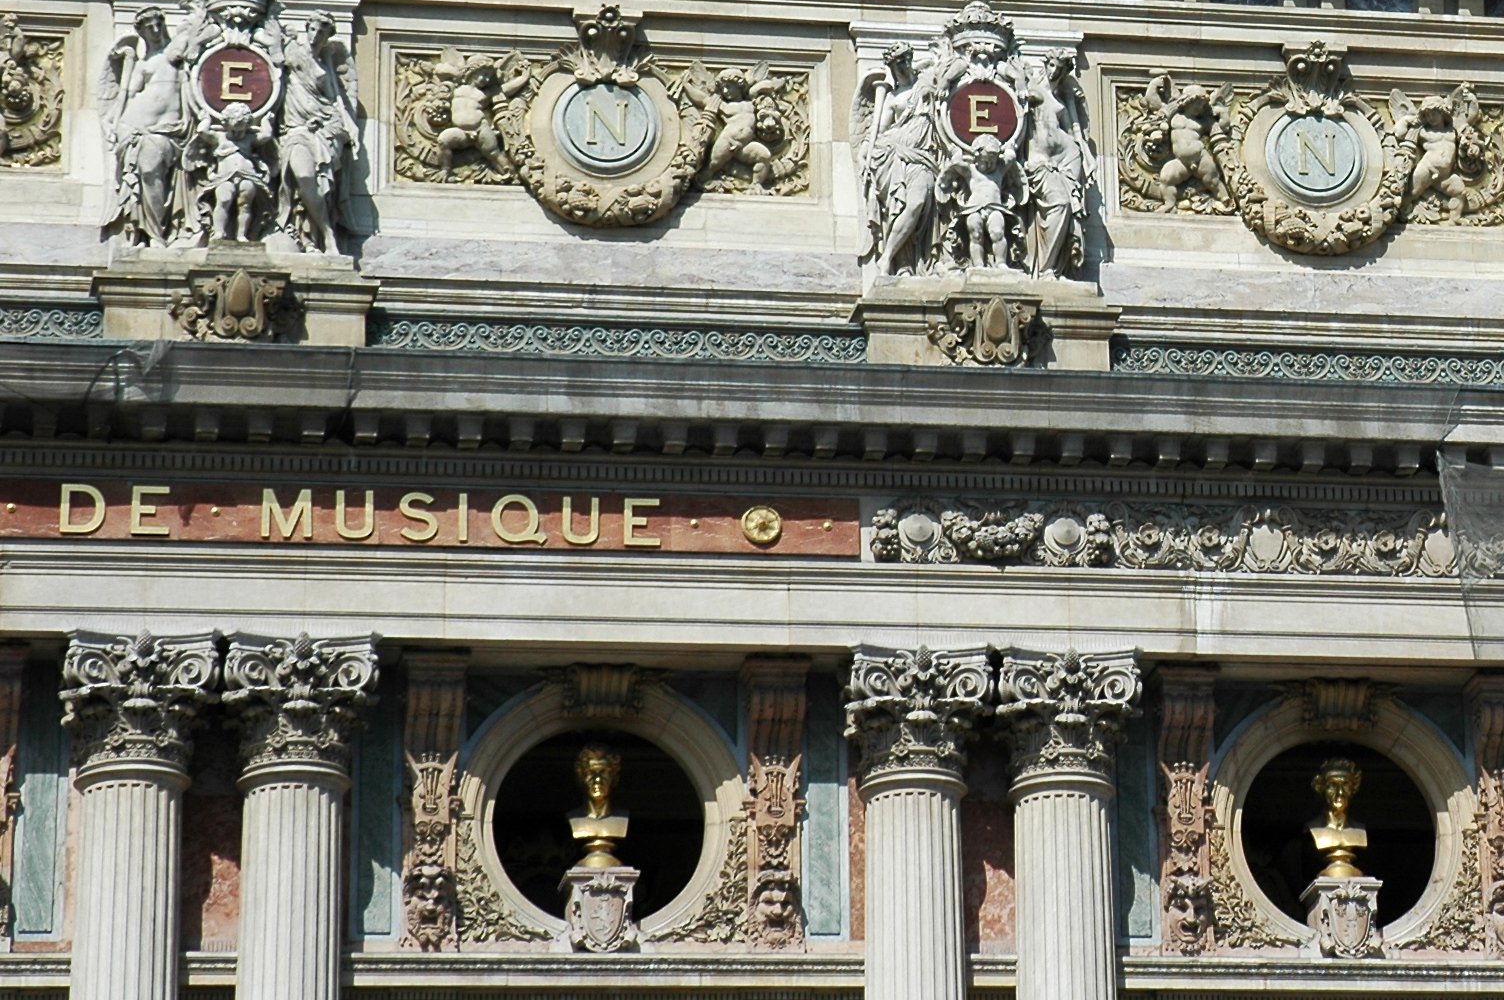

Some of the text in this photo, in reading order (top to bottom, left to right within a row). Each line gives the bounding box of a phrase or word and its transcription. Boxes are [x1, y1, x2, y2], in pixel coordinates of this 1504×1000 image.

[220, 61, 253, 101] E
[586, 99, 628, 146] N
[968, 94, 999, 133] E
[1296, 130, 1335, 176] N
[59, 483, 661, 547] DE MUSIQUE
